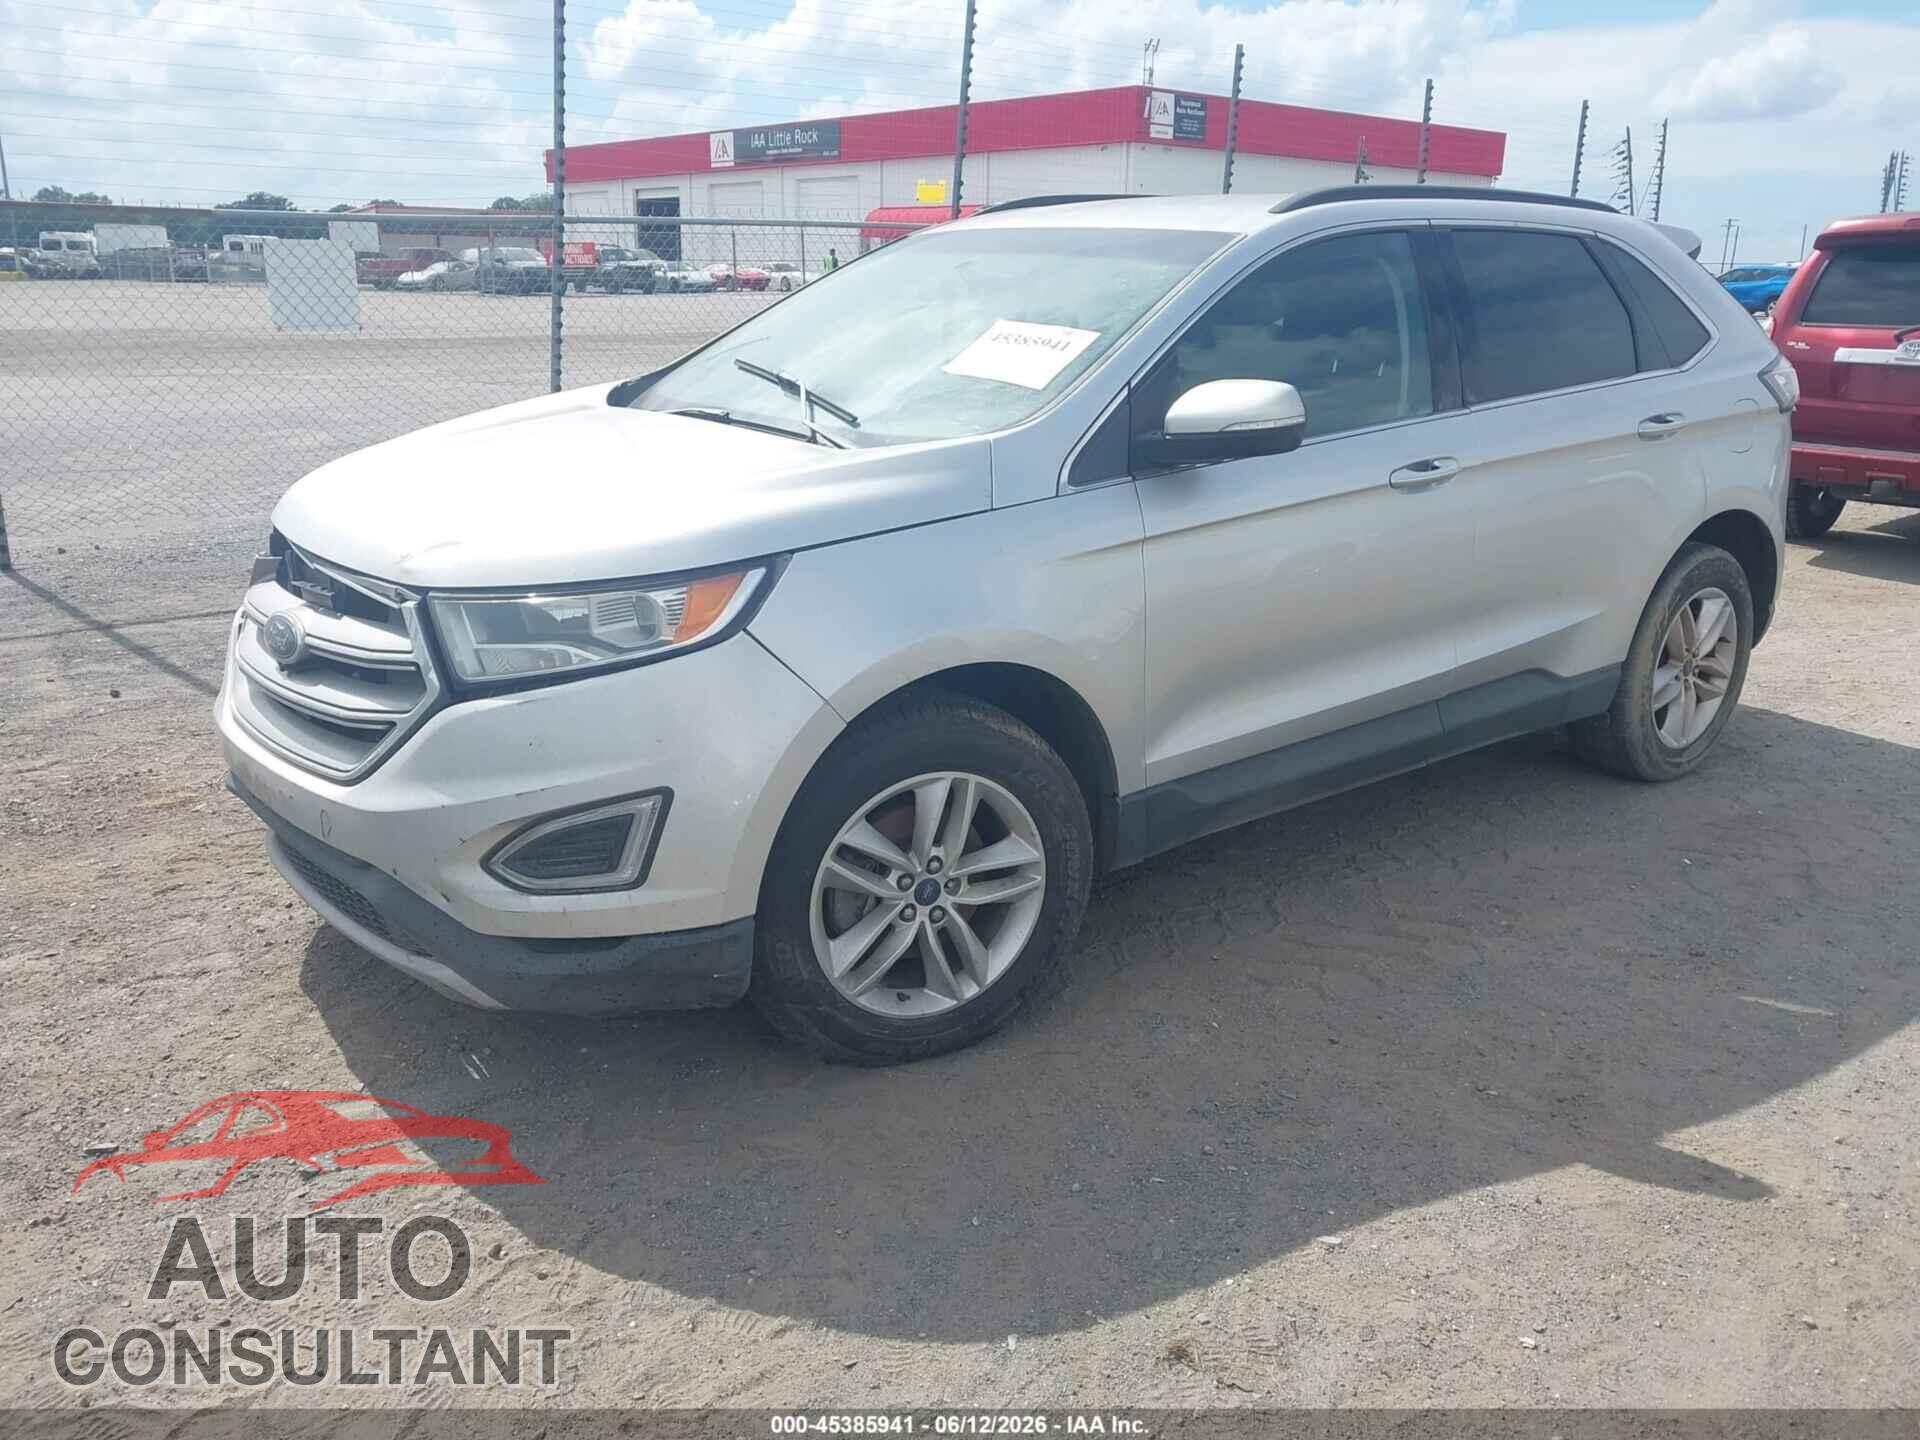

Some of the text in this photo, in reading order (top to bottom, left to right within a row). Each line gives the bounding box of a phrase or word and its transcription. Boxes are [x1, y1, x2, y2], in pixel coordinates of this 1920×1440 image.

[751, 127, 818, 148] IAA Little Rock
